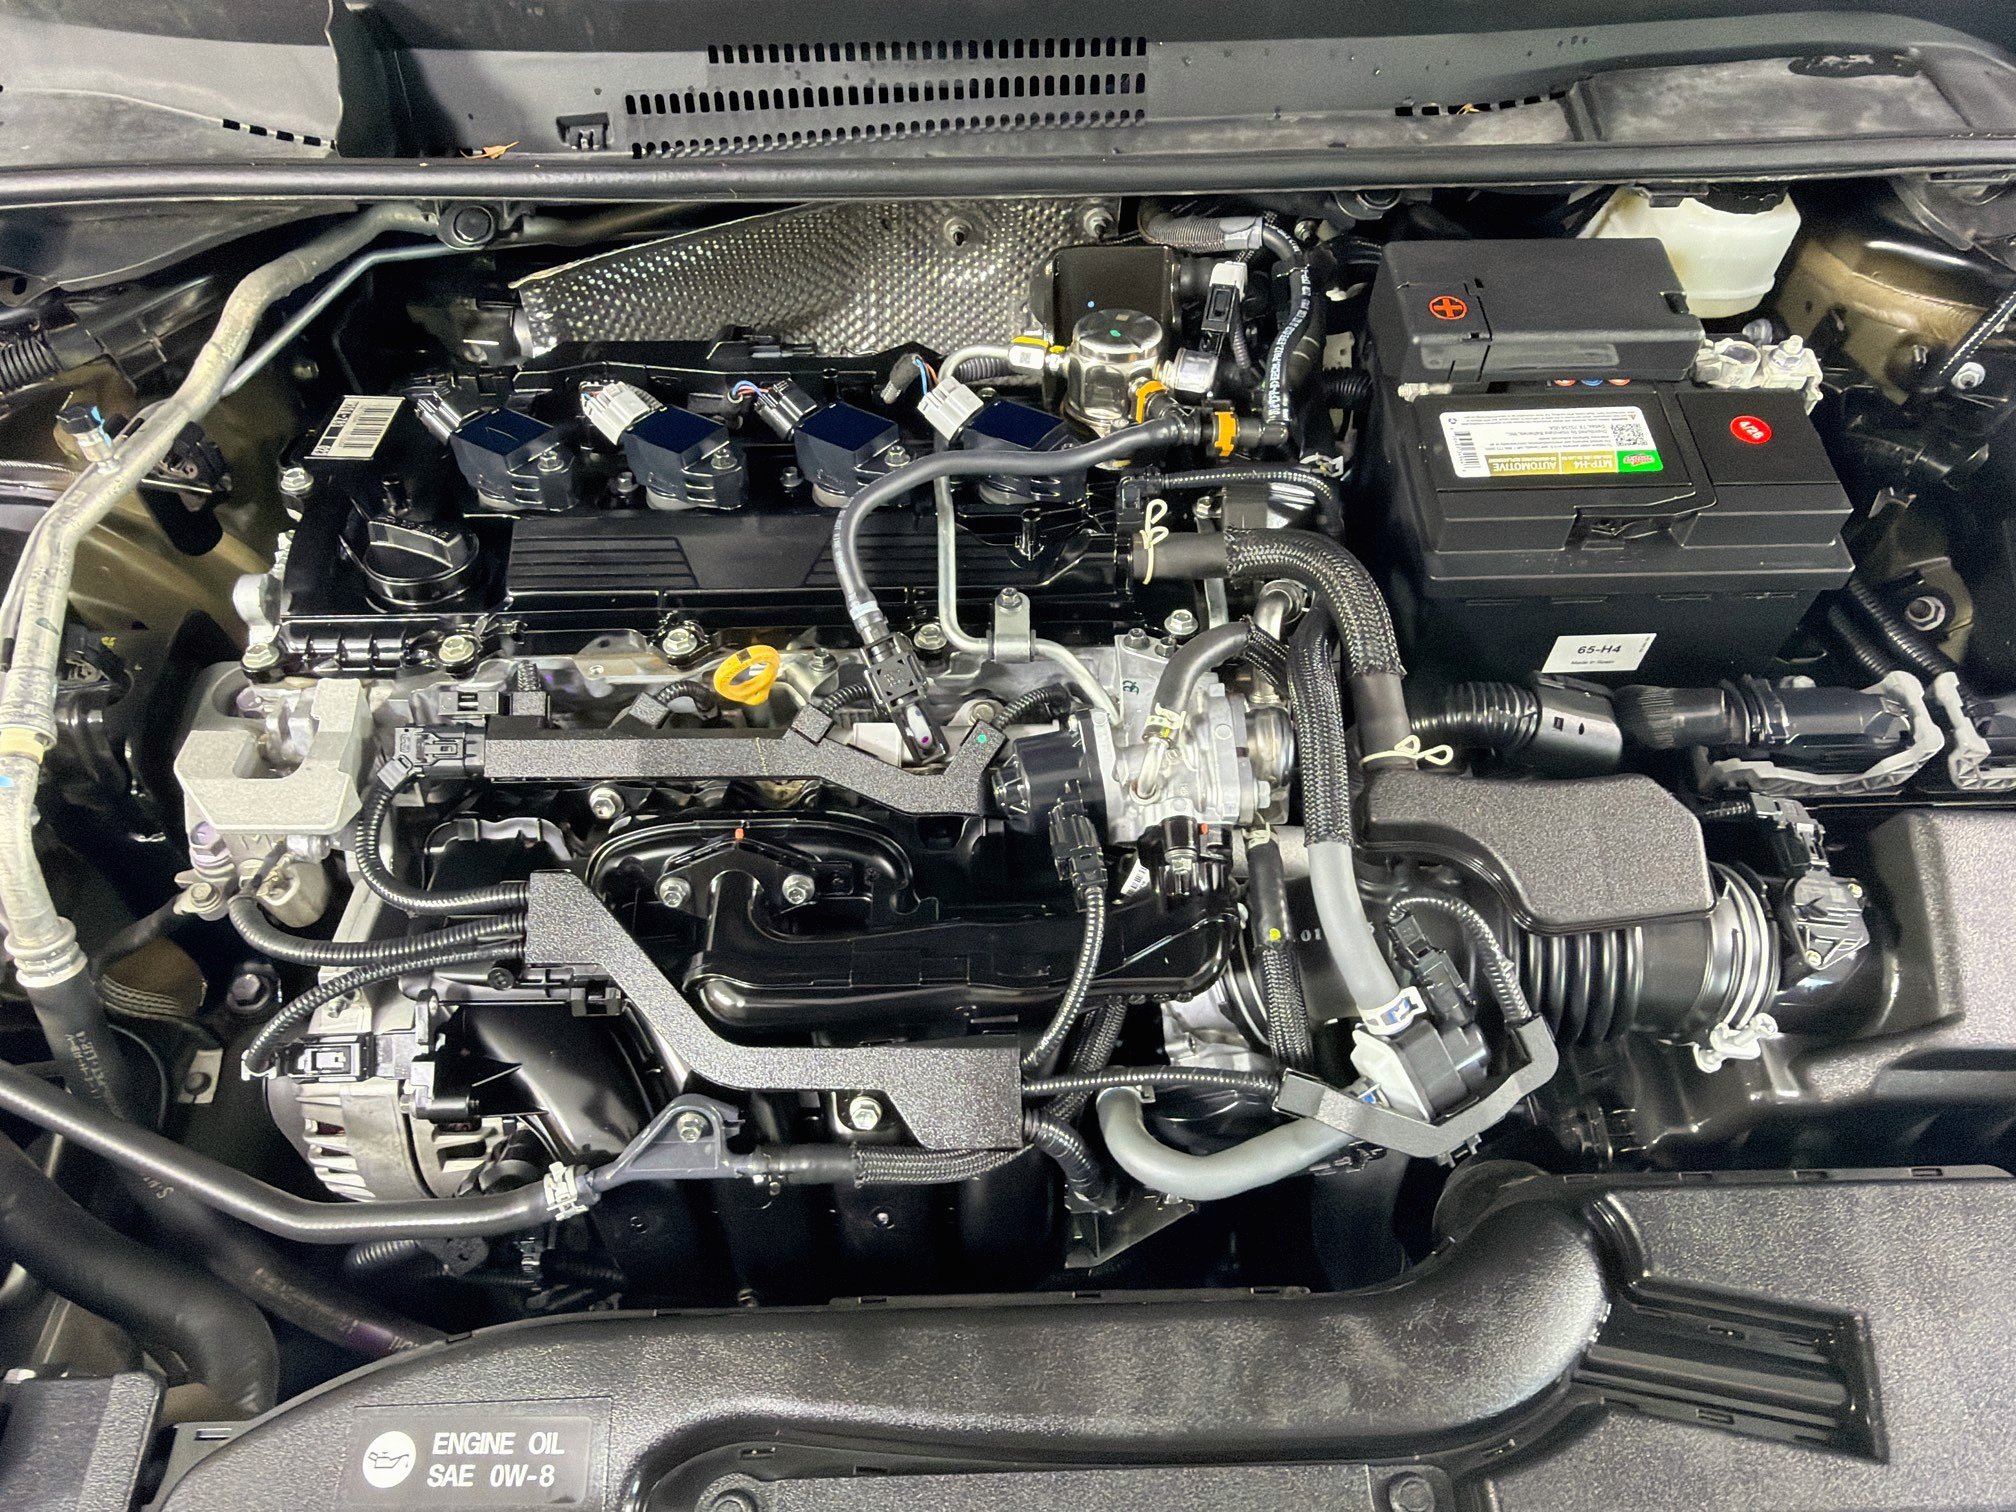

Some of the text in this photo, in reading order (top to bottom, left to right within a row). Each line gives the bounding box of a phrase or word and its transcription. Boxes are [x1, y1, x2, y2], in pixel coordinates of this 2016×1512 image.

[1493, 461, 1558, 472] AUTOMOTIVE
[1573, 459, 1613, 468] MTP-H4
[1577, 645, 1622, 654] 65-H4
[432, 1432, 565, 1455] ENGINE OIL
[426, 1463, 556, 1488] SAE 0W-8
